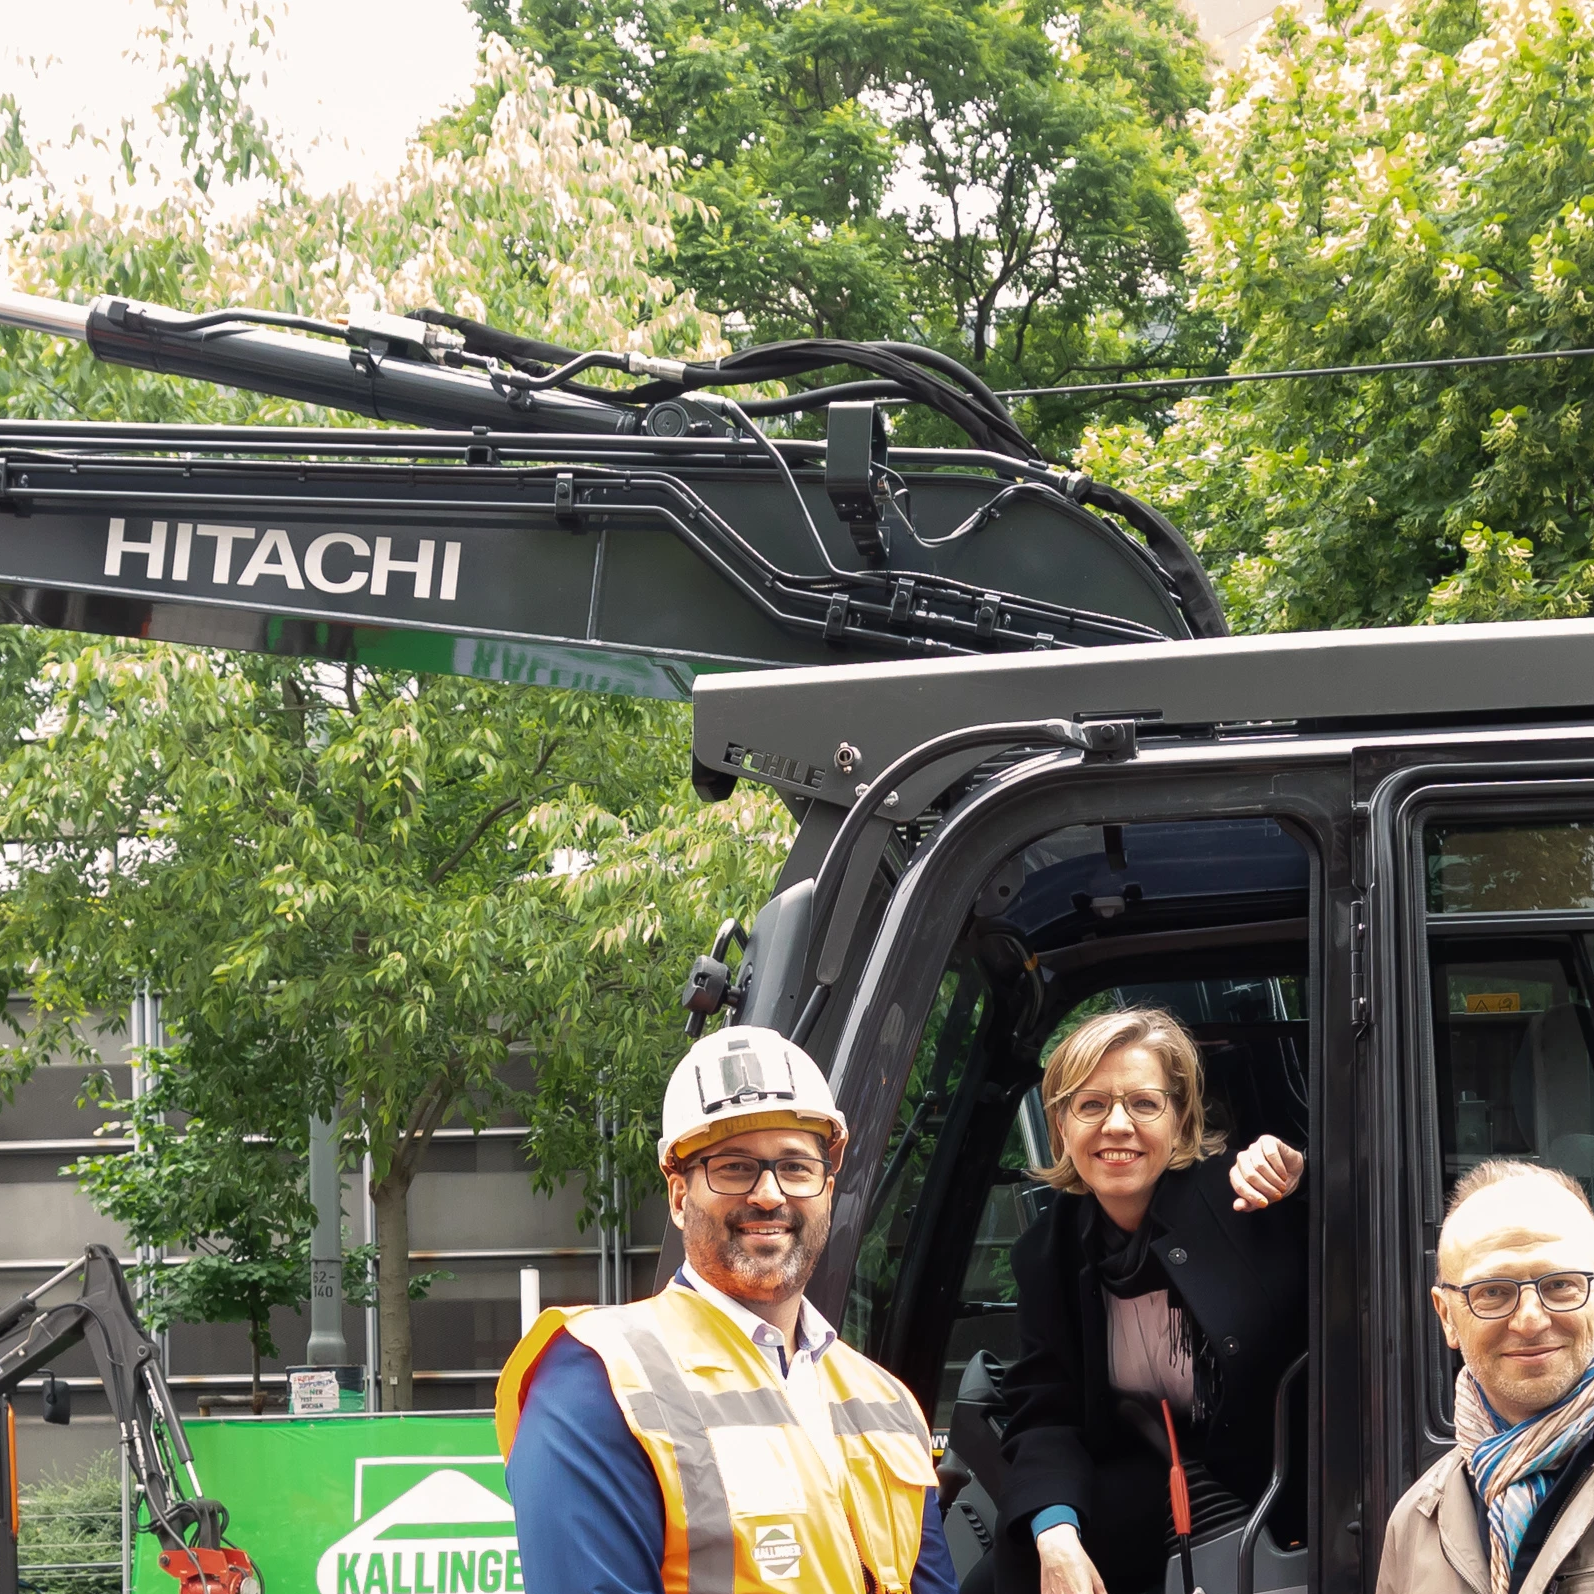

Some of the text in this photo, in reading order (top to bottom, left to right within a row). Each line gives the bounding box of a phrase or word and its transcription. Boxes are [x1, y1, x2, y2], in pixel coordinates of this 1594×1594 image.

[104, 517, 462, 600] HITACHI
[721, 742, 826, 791] ECHLE
[313, 1285, 334, 1298] 140
